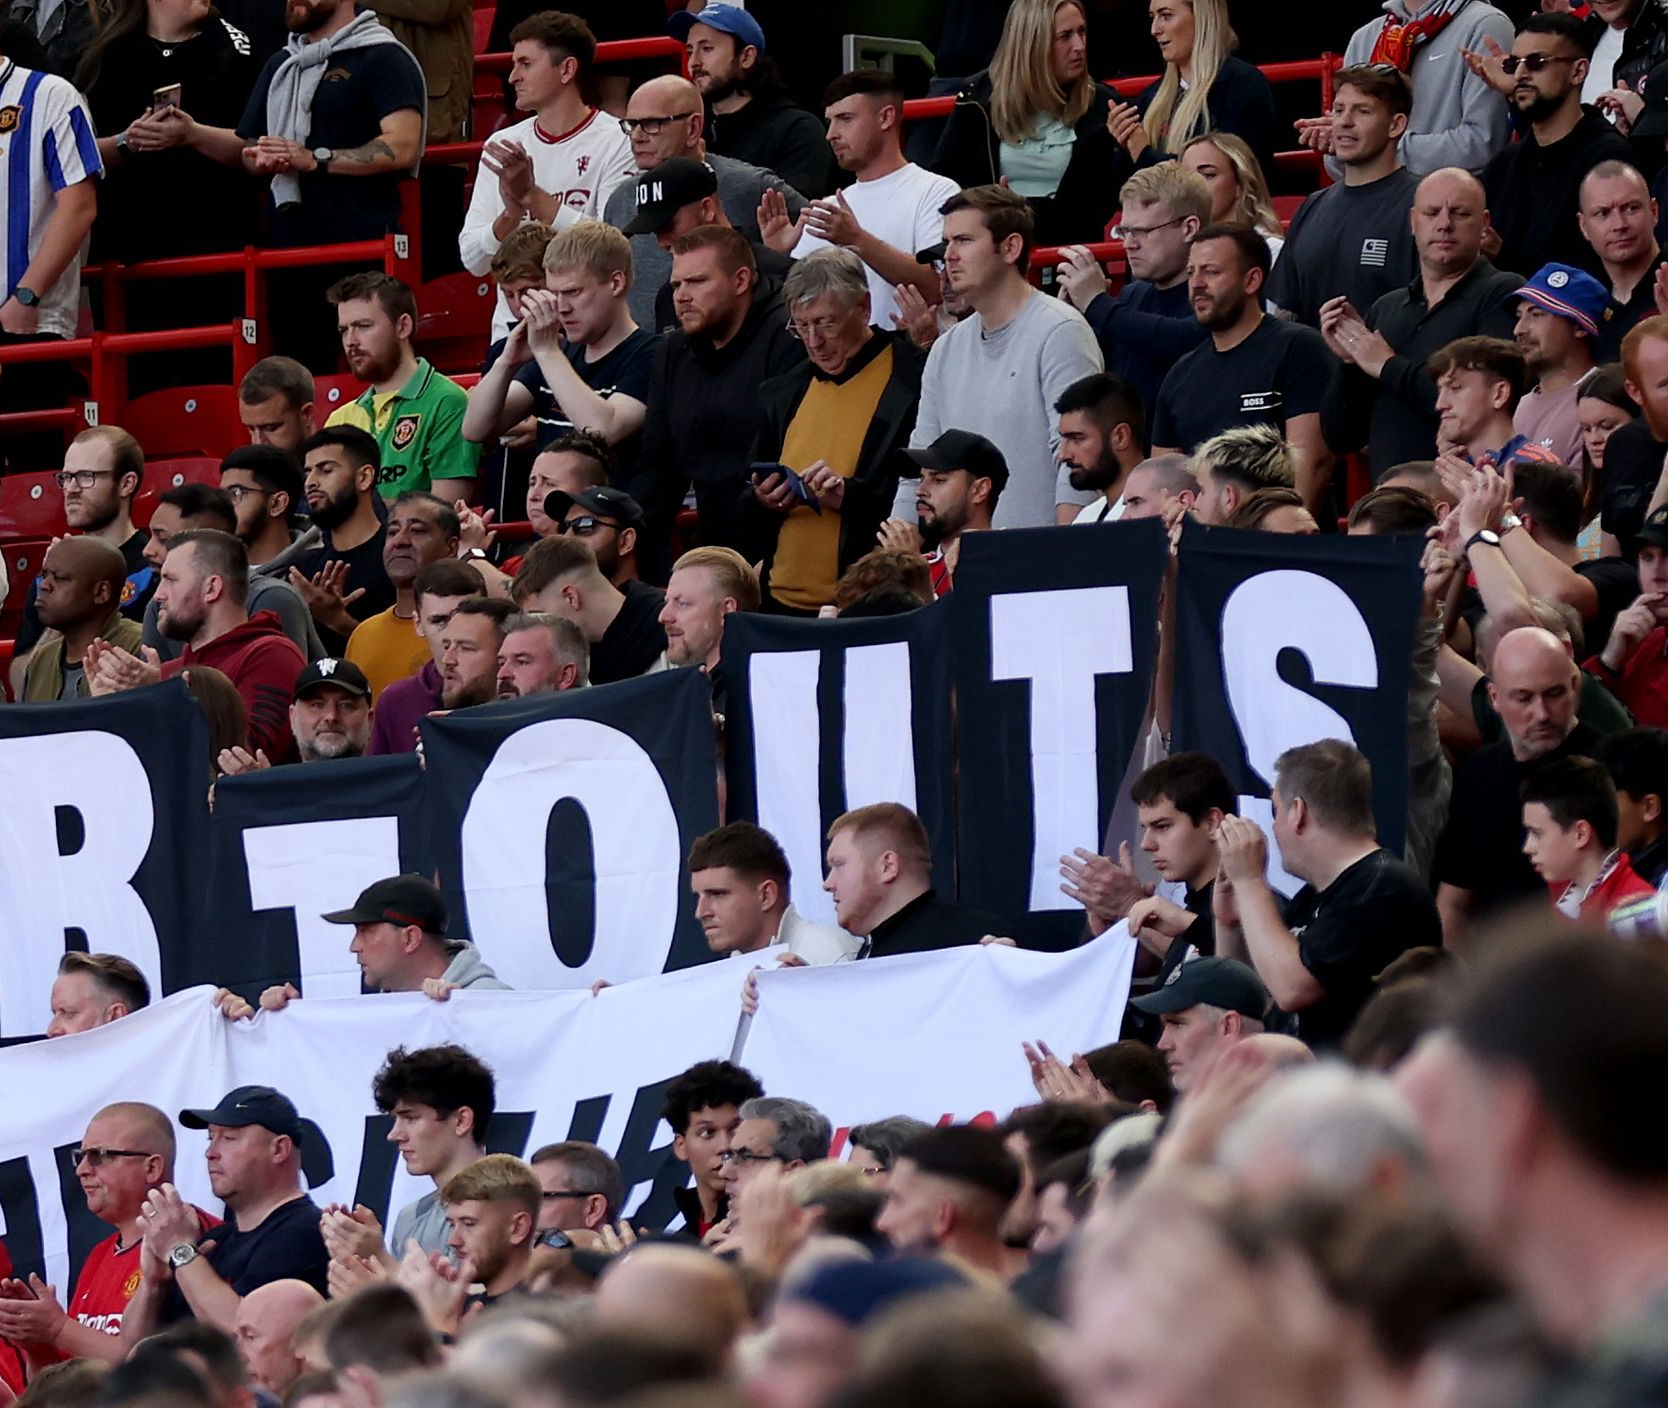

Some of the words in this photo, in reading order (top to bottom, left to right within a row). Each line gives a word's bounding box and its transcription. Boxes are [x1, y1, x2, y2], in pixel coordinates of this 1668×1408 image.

[397, 241, 407, 253] 13
[245, 326, 255, 338] 12
[1243, 397, 1265, 407] BOSS
[86, 409, 96, 421] 11
